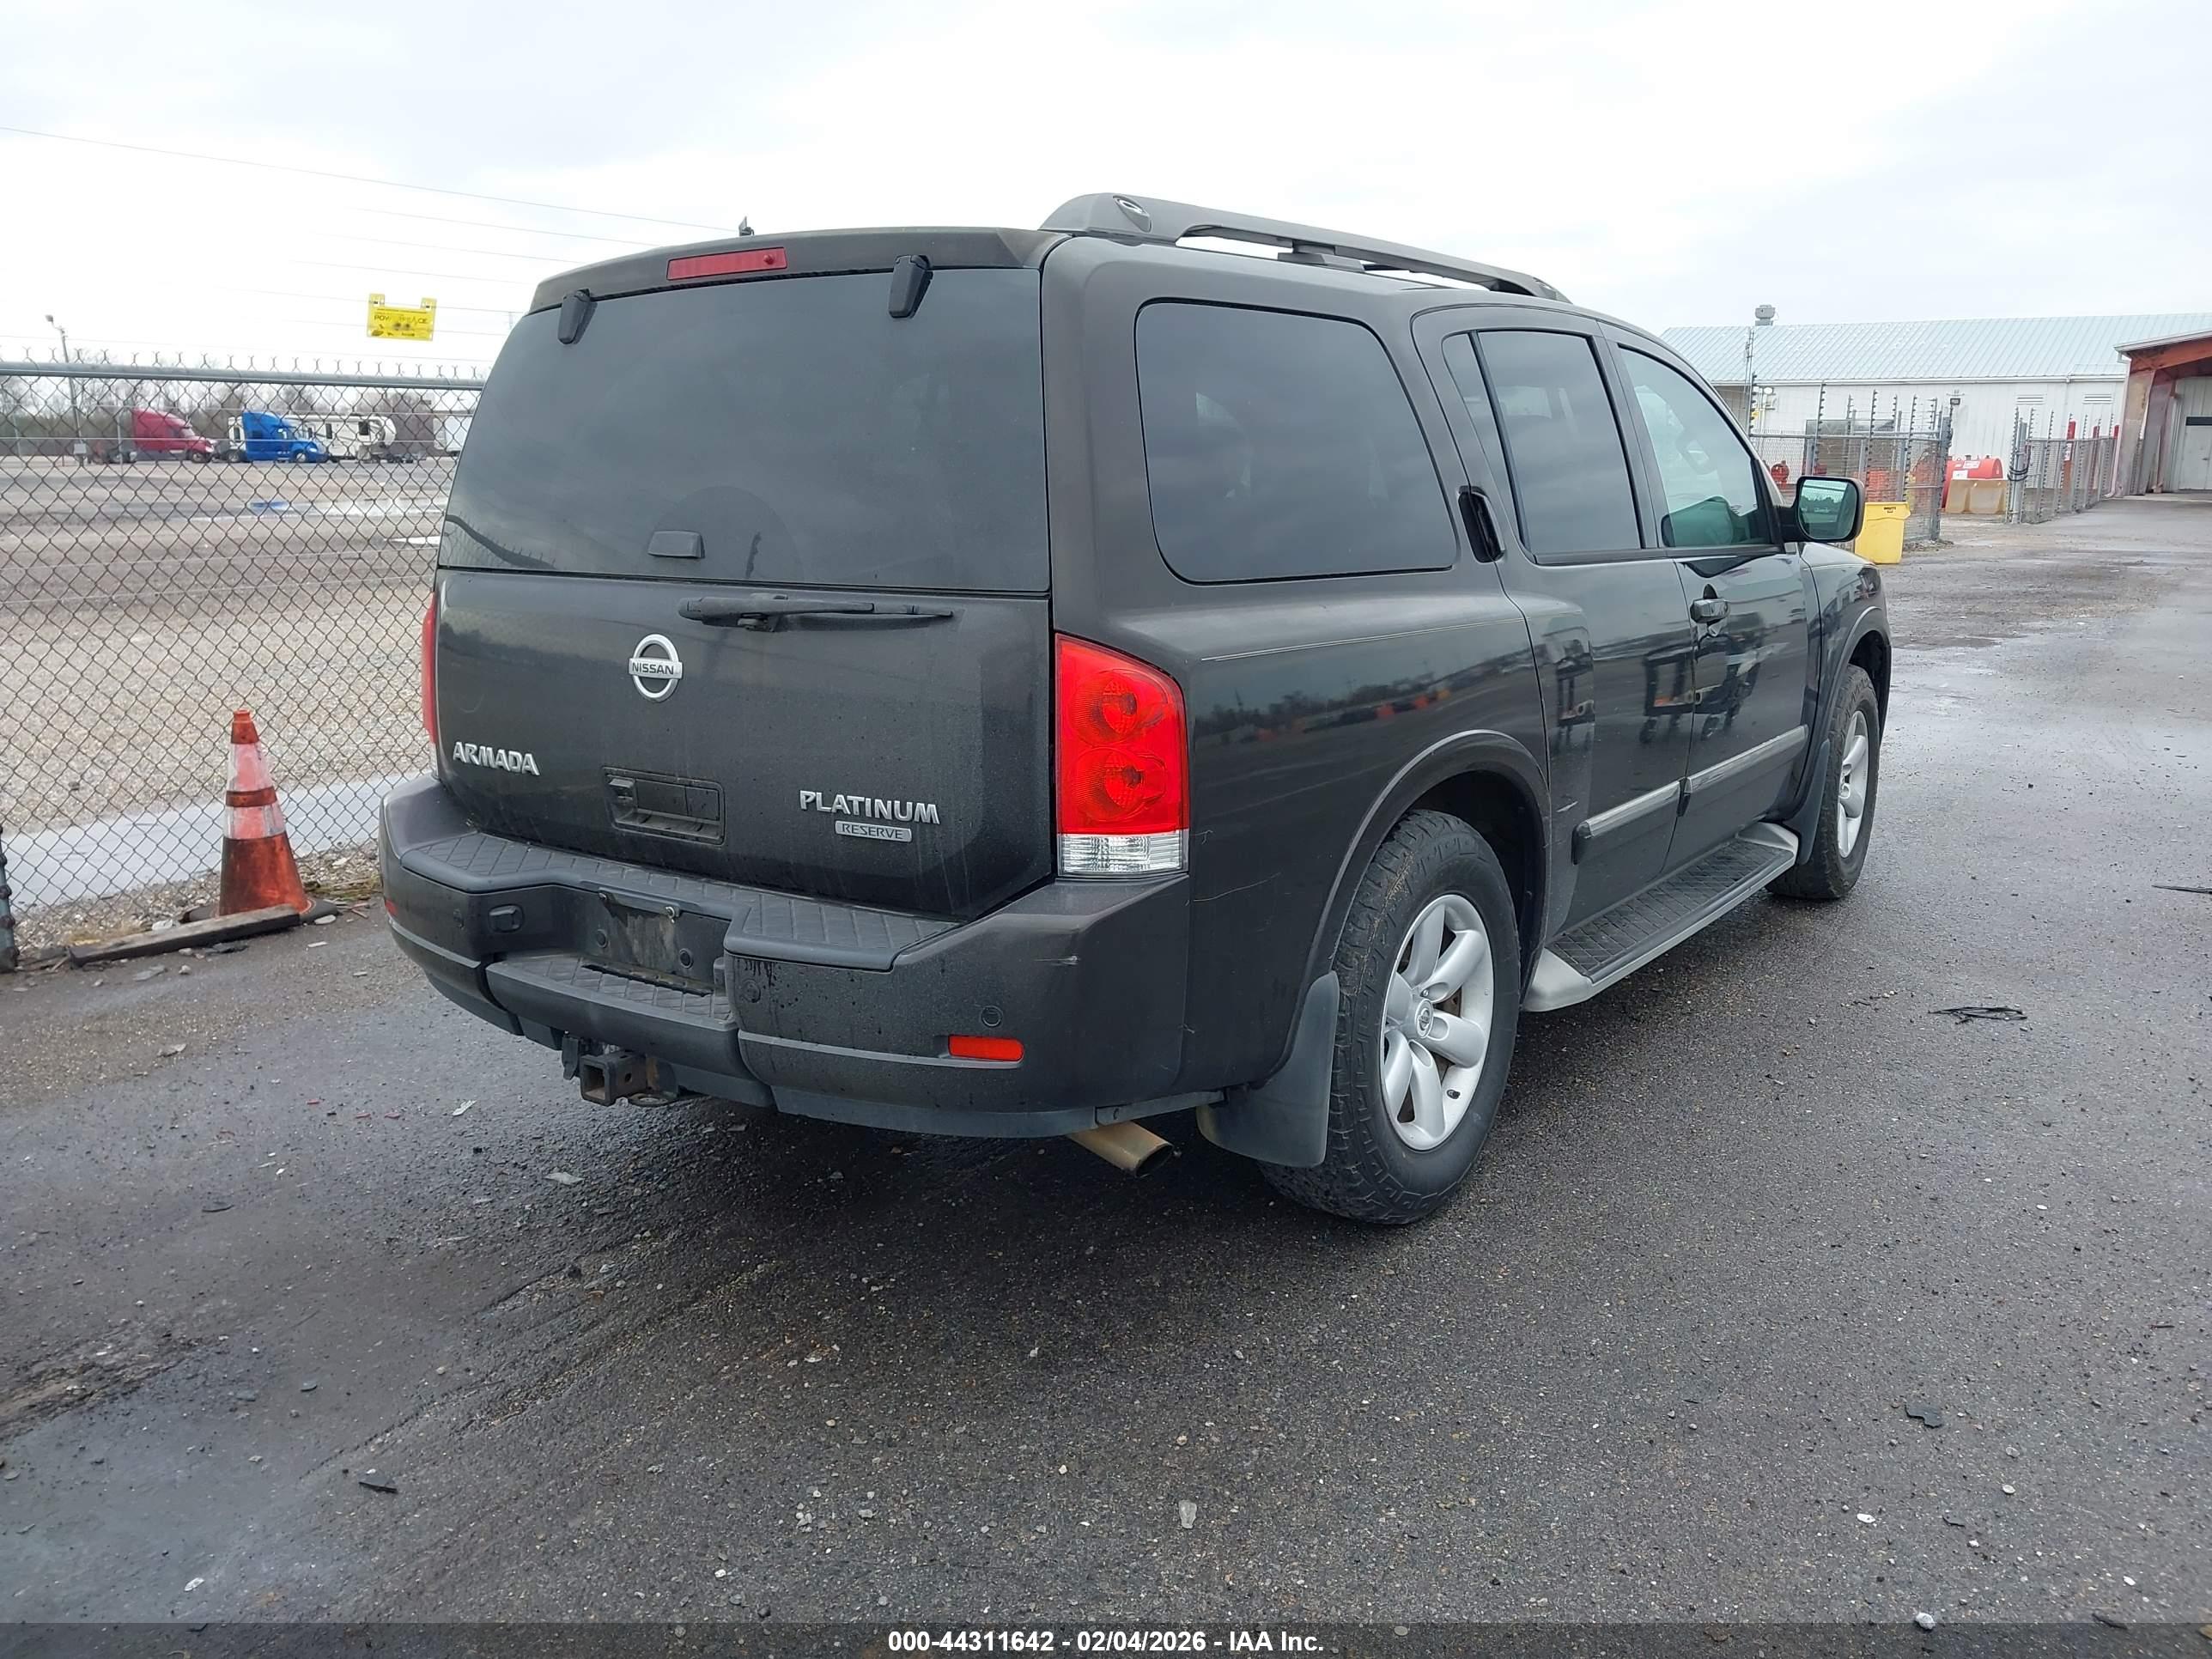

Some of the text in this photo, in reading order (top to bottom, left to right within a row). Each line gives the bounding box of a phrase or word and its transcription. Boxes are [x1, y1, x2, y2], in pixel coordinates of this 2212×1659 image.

[632, 662, 674, 675] NISSAN
[453, 741, 540, 776] ARMADA
[799, 790, 940, 825] PLATINUM
[842, 823, 902, 840] RESERVE
